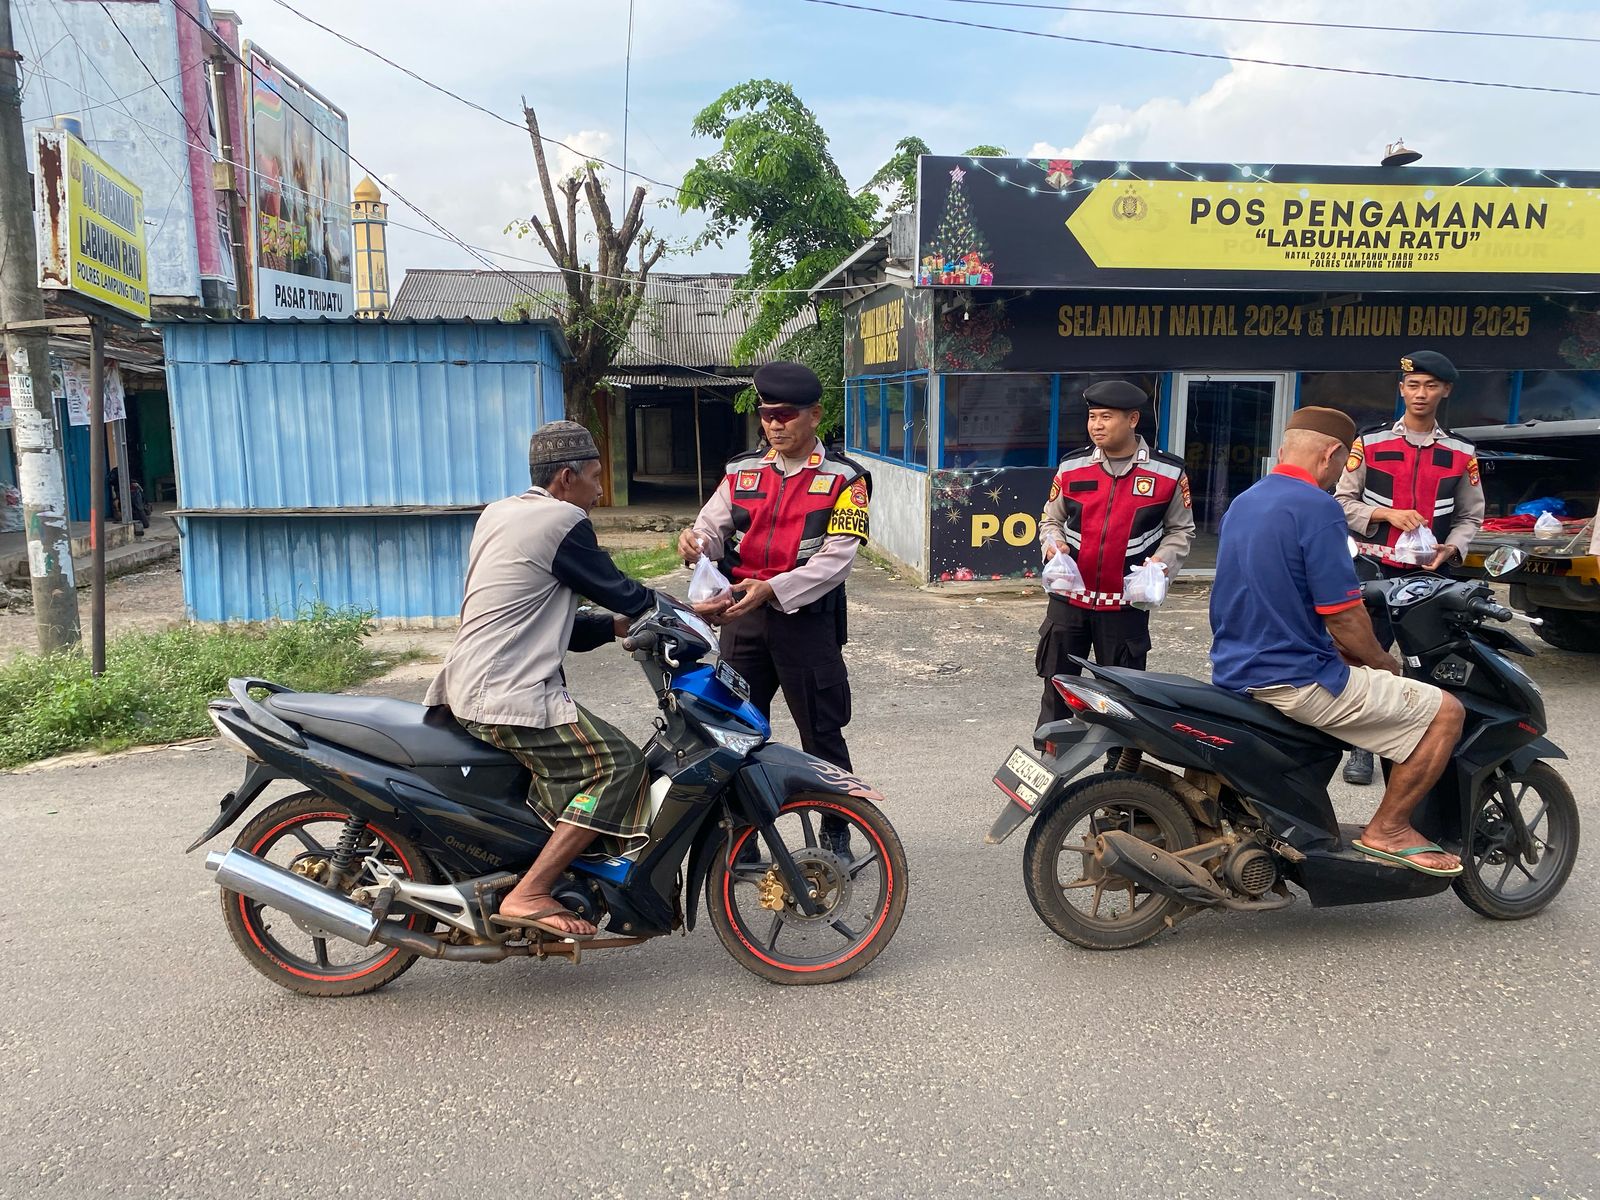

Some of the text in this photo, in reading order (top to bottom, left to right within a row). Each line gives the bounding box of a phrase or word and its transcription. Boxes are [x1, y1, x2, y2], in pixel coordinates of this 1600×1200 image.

[1190, 197, 1266, 227] POS
[1282, 200, 1548, 230] PENGAMANAN
[79, 215, 143, 283] LABUHAN RATU
[1284, 251, 1440, 261] NATAL 2024 DAN TAHUN BARU 2025
[1309, 260, 1413, 268] POLRES LAMPUNG TIMUR
[76, 261, 147, 307] POLRES LAMPUNG TIMUR
[274, 283, 344, 313] PASAR TRIDATU
[1058, 304, 1531, 338] SELAMAT NATAL 2024 & TAHUN BARU 2025
[1008, 752, 1022, 769] BE
[445, 835, 466, 850] One
